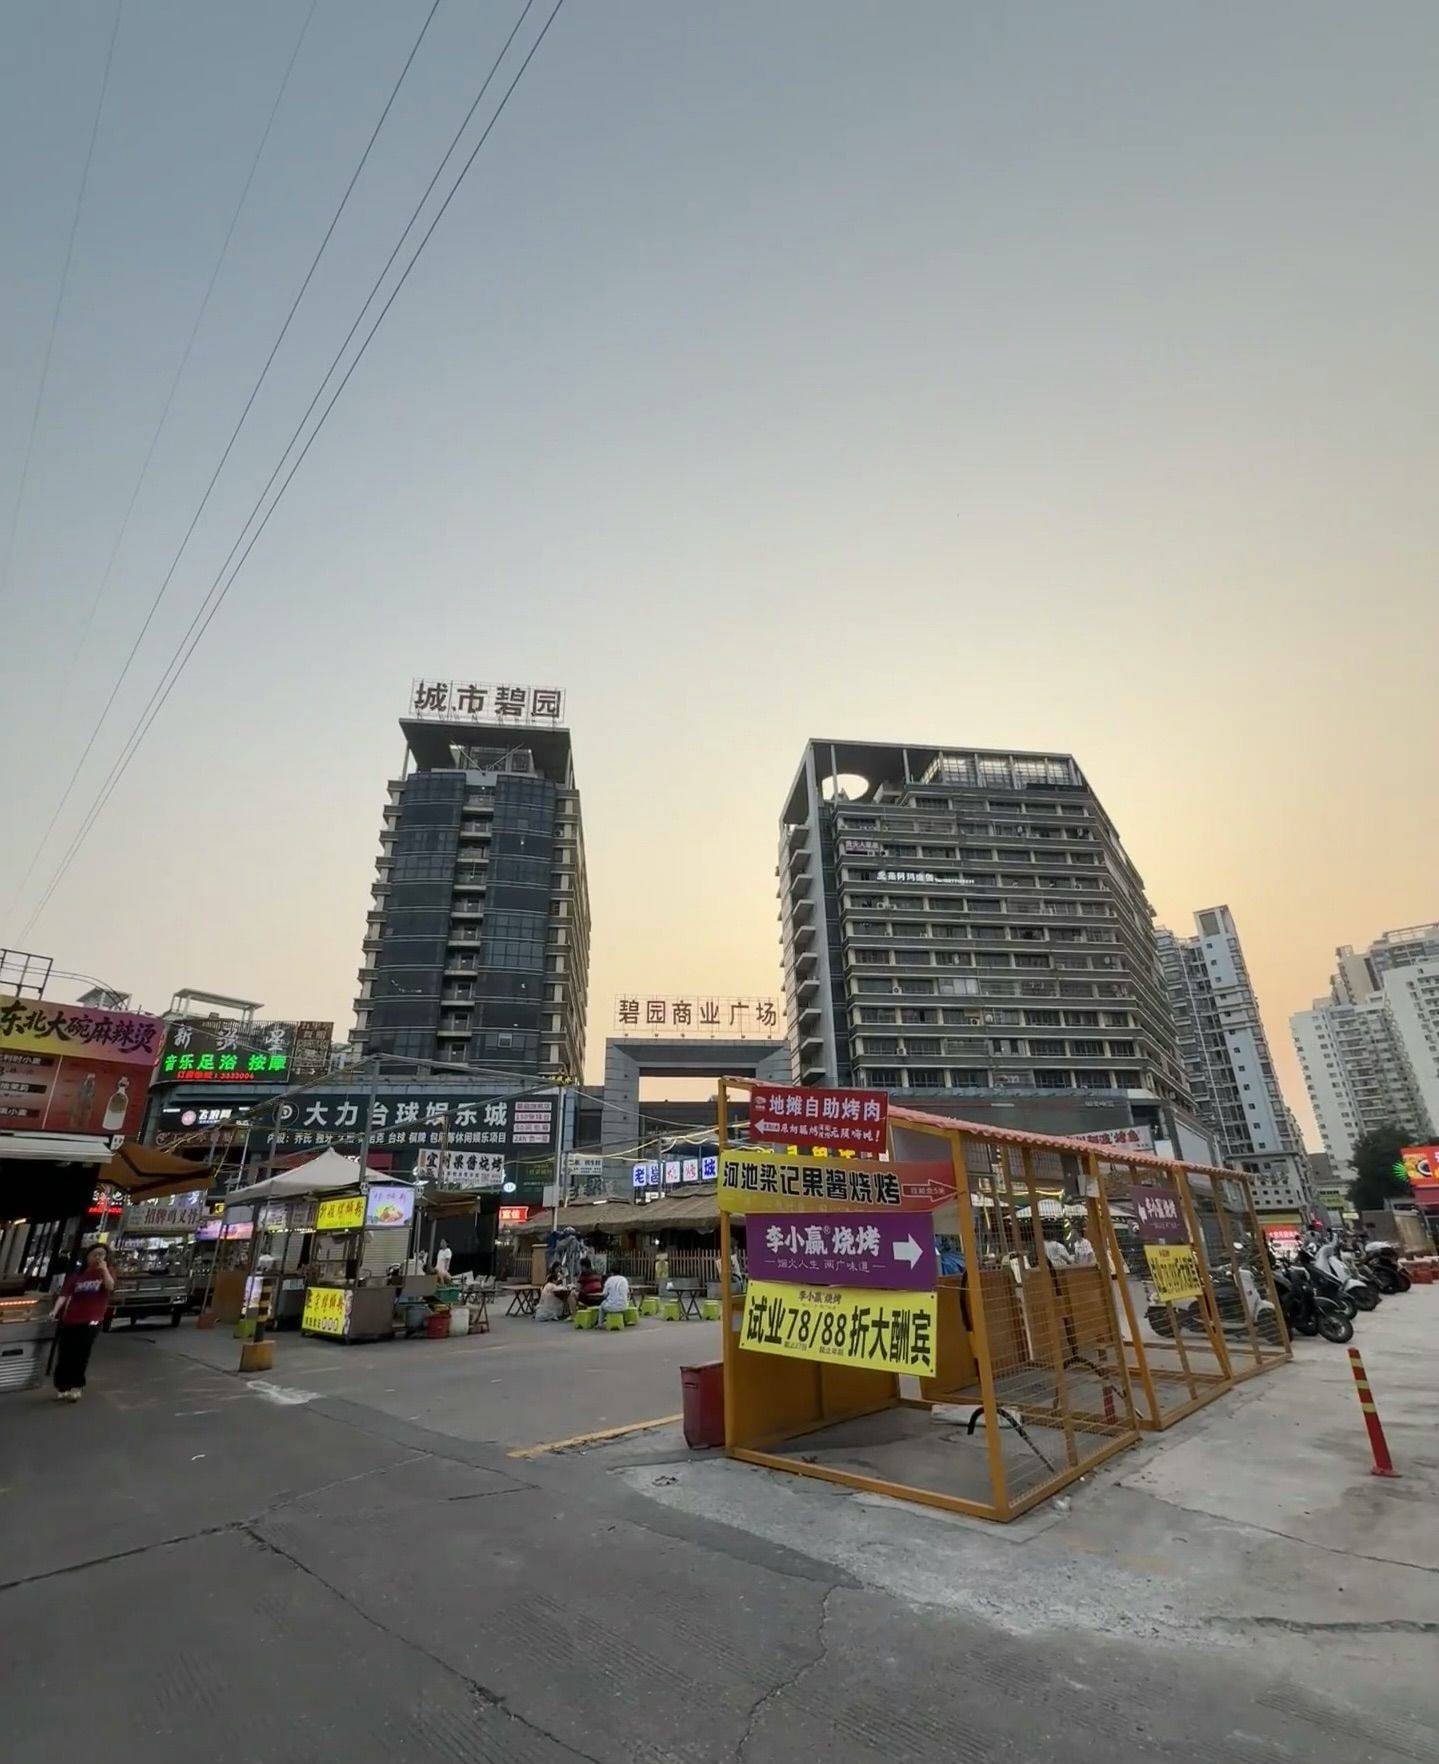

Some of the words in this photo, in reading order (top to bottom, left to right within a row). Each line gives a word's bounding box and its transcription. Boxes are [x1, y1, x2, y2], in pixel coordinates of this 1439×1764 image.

[414, 683, 560, 717] 城市碧园
[619, 1000, 778, 1026] 碧园商业广场
[0, 1000, 156, 1053] 东北大碗麻辣烫
[165, 1053, 238, 1072] 音乐足浴
[248, 1054, 286, 1071] 按摩
[303, 1101, 507, 1126] 大力台球娱乐城
[769, 1095, 880, 1121] 地摊自助烤肉
[388, 1132, 406, 1143] 台球
[722, 1161, 900, 1205] 河池梁记果酱烧烤
[747, 1296, 931, 1366] 试业78/88折大酬宾
